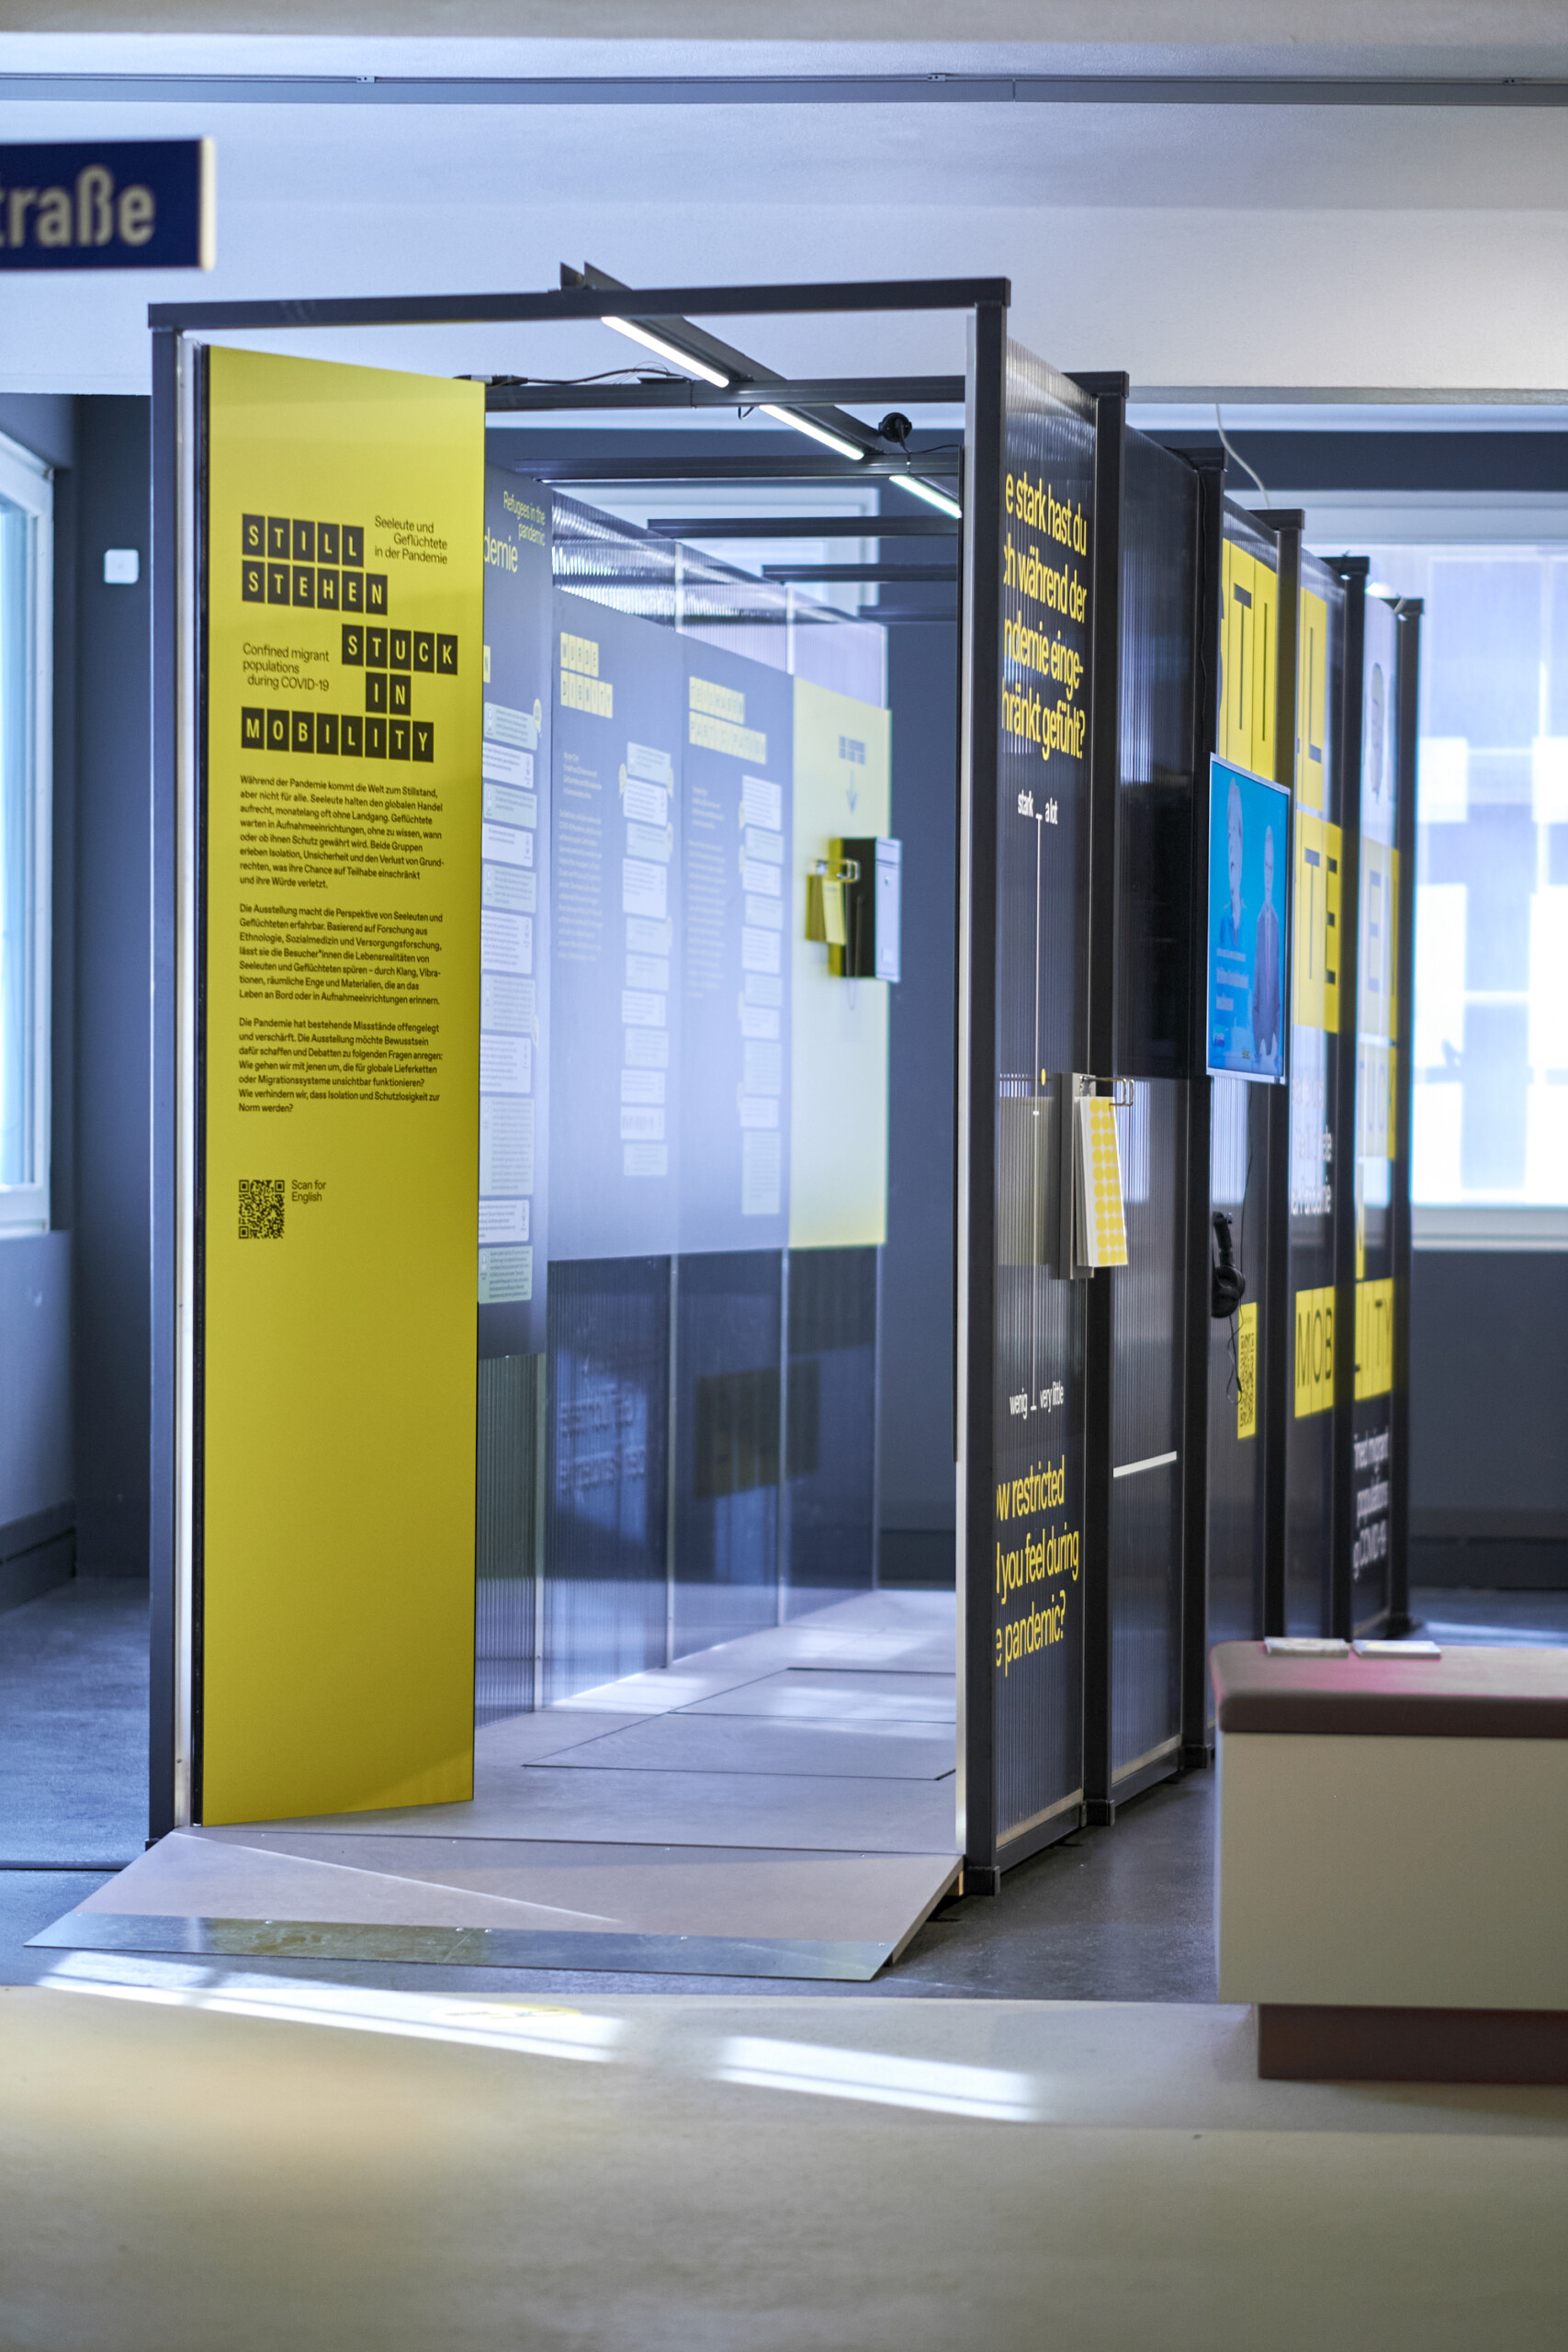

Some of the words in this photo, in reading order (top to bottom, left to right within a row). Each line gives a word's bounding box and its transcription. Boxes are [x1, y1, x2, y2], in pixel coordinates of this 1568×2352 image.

[503, 491, 530, 520] Refugees
[536, 505, 546, 526] the
[1016, 470, 1047, 534] stark
[1048, 483, 1072, 548] hast
[1073, 503, 1088, 557] du
[374, 515, 414, 531] Seeleute
[416, 522, 434, 534] und
[247, 524, 357, 558] STILL
[393, 533, 448, 551] Geflüchtete
[375, 546, 384, 557] in
[386, 547, 400, 560] der
[401, 548, 448, 565] Pandemie
[247, 571, 383, 605] STEHEN
[1017, 545, 1068, 615] während
[1069, 569, 1088, 624] der
[243, 643, 289, 659] Confined
[290, 647, 330, 663] migrant
[347, 634, 453, 666] STUCK
[1003, 610, 1049, 676] ndemie
[1050, 630, 1084, 701] einge-
[243, 660, 299, 675] populations
[247, 675, 279, 691] during
[280, 676, 330, 692] COVID-19
[373, 682, 407, 707] IN
[245, 717, 428, 752] MOBILITY
[1042, 699, 1086, 761] gefühlt?
[240, 775, 274, 786] Während
[276, 776, 288, 786] der
[289, 777, 326, 789] Pandemie
[327, 780, 354, 791] kommt
[355, 782, 367, 792] die
[367, 783, 384, 793] Welt
[385, 786, 400, 794] zum
[275, 805, 319, 820] monatelang
[320, 808, 331, 818] oft
[332, 808, 351, 819] ohne
[390, 812, 432, 824] Geflüchtete
[240, 817, 266, 828] warten
[367, 825, 385, 835] ohne
[423, 830, 442, 839] wann
[272, 864, 287, 872] was
[288, 863, 303, 873] ihre
[303, 864, 333, 875] Chance
[333, 865, 345, 876] auf
[346, 865, 377, 876] Teilhabe
[378, 867, 420, 879] einschränkt
[239, 875, 254, 885] und
[255, 876, 270, 886] ihre
[271, 876, 296, 887] Würde
[239, 917, 288, 929] Geflüchteten
[326, 921, 363, 932] Basierend
[364, 922, 376, 933] auf
[377, 923, 414, 936] Forschung
[285, 933, 338, 944] Sozialmedizin
[339, 935, 355, 945] und
[239, 945, 257, 956] lässt
[258, 946, 269, 956] sie
[270, 947, 282, 956] die
[343, 950, 354, 959] die
[355, 950, 415, 962] Lebensrealitäten
[416, 955, 429, 963] von
[239, 960, 276, 970] Seeleuten
[277, 961, 292, 971] und
[293, 962, 342, 973] Geflüchteten
[342, 964, 367, 977] spüren
[374, 965, 395, 975] durch
[419, 967, 440, 977] Vibra-
[239, 989, 263, 999] Leben
[275, 989, 293, 1000] Bord
[294, 990, 311, 1000] oder
[320, 991, 408, 1005] Aufnahmeeinrichtungen
[239, 1016, 252, 1026] Die
[254, 1017, 292, 1027] Pandemie
[293, 1018, 306, 1028] hat
[307, 1018, 352, 1029] bestehende
[353, 1020, 396, 1030] Missstände
[397, 1021, 439, 1034] offengelegt
[238, 1031, 254, 1040] und
[297, 1033, 310, 1042] Die
[310, 1033, 354, 1046] Ausstellung
[355, 1034, 383, 1044] möchte
[384, 1035, 428, 1045] Bewusstsein
[238, 1045, 258, 1055] dafür
[259, 1046, 292, 1056] schaffen
[292, 1046, 307, 1056] und
[308, 1046, 342, 1057] Debatten
[352, 1047, 387, 1060] folgenden
[388, 1048, 412, 1061] Fragen
[238, 1073, 256, 1083] oder
[257, 1074, 331, 1087] Migrationssysteme
[332, 1075, 371, 1085] unsichtbar
[372, 1076, 424, 1087] funktionieren?
[238, 1088, 253, 1097] Wie
[254, 1088, 294, 1098] verhindern
[309, 1089, 326, 1099] dass
[327, 1090, 358, 1099] Isolation
[359, 1090, 373, 1100] und
[374, 1091, 428, 1102] Schutzlosigkeit
[238, 1102, 260, 1112] Norm
[261, 1102, 293, 1112] werden?
[291, 1180, 313, 1190] Scan
[314, 1180, 326, 1190] for
[291, 1191, 322, 1204] English
[1009, 1386, 1028, 1420] wenig
[1039, 1388, 1053, 1413] very
[1052, 1379, 1064, 1406] little
[1012, 1454, 1065, 1518] restricted
[1000, 1548, 1024, 1605] you
[1024, 1529, 1045, 1584] feel
[1046, 1521, 1079, 1581] during
[1004, 1589, 1066, 1677] pandemic?
